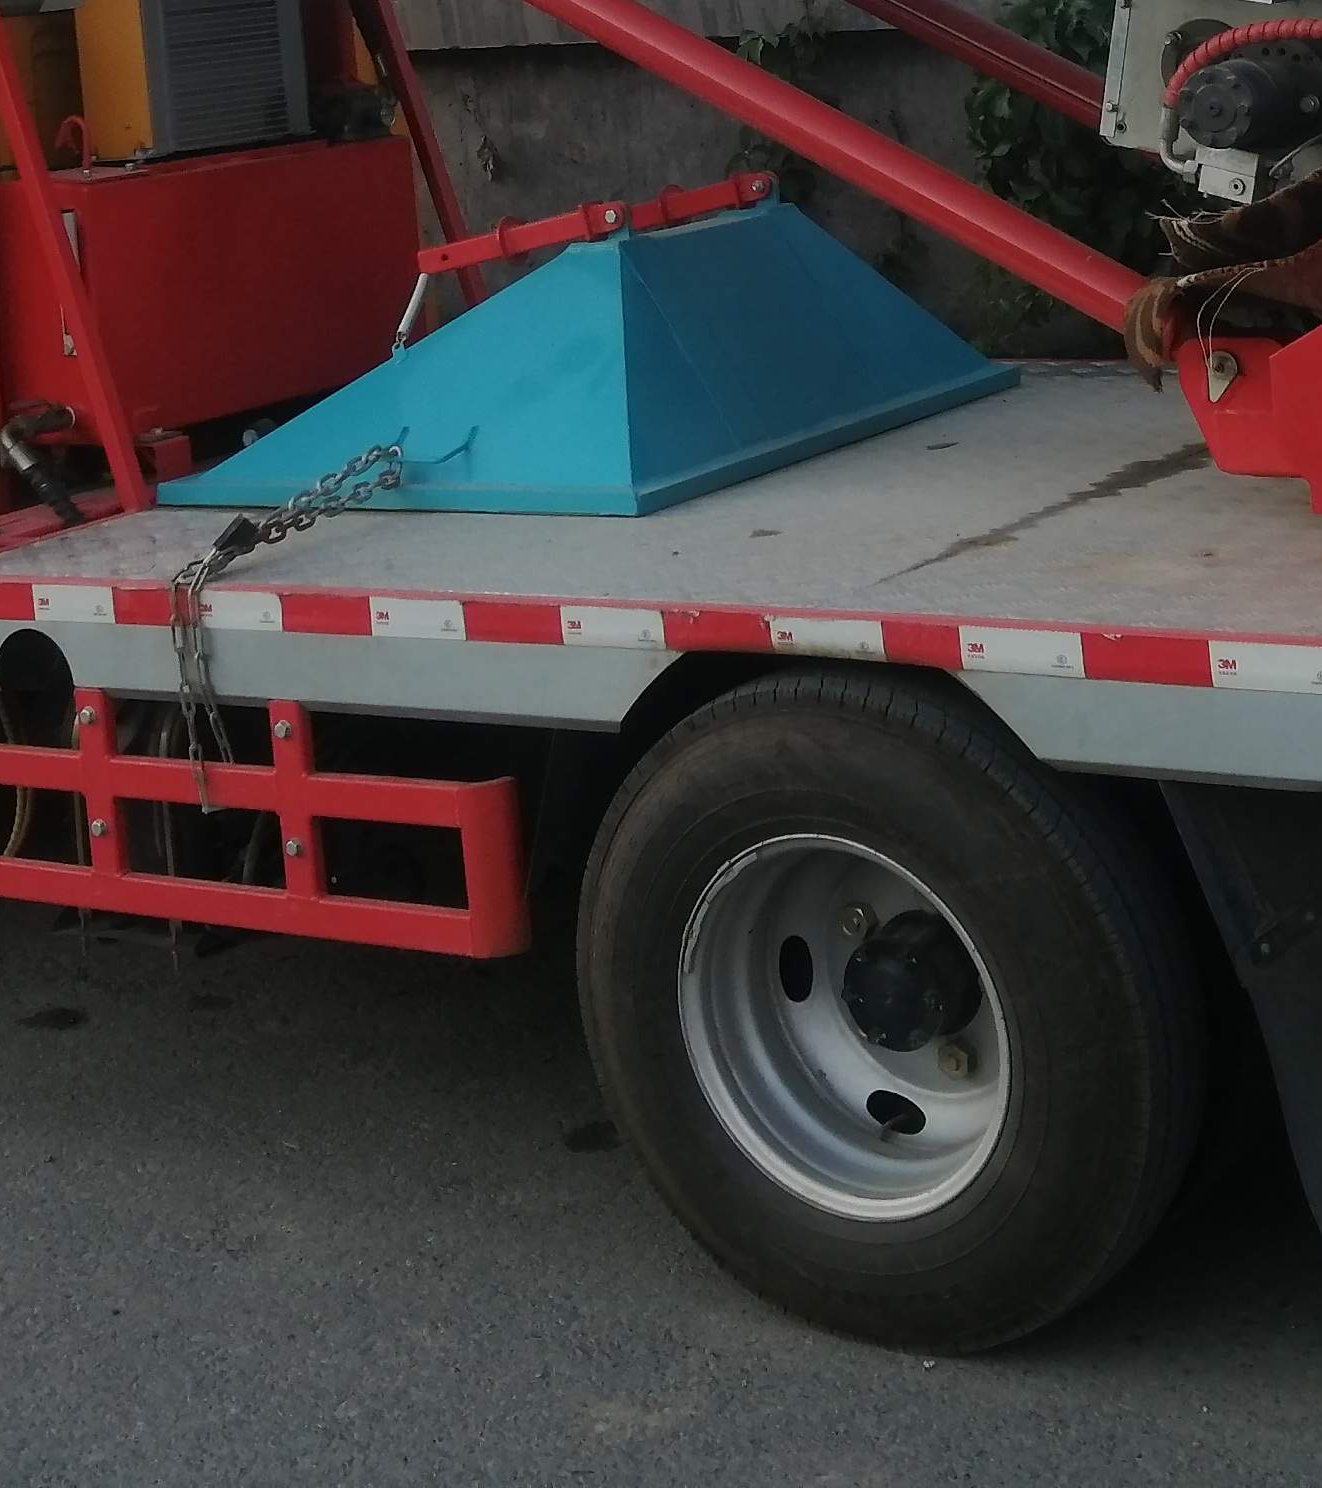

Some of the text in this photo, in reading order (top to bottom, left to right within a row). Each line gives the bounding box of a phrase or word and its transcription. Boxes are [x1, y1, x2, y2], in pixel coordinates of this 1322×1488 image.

[776, 630, 794, 642] 3M
[966, 642, 985, 654] 3M
[1217, 658, 1237, 670] 3M
